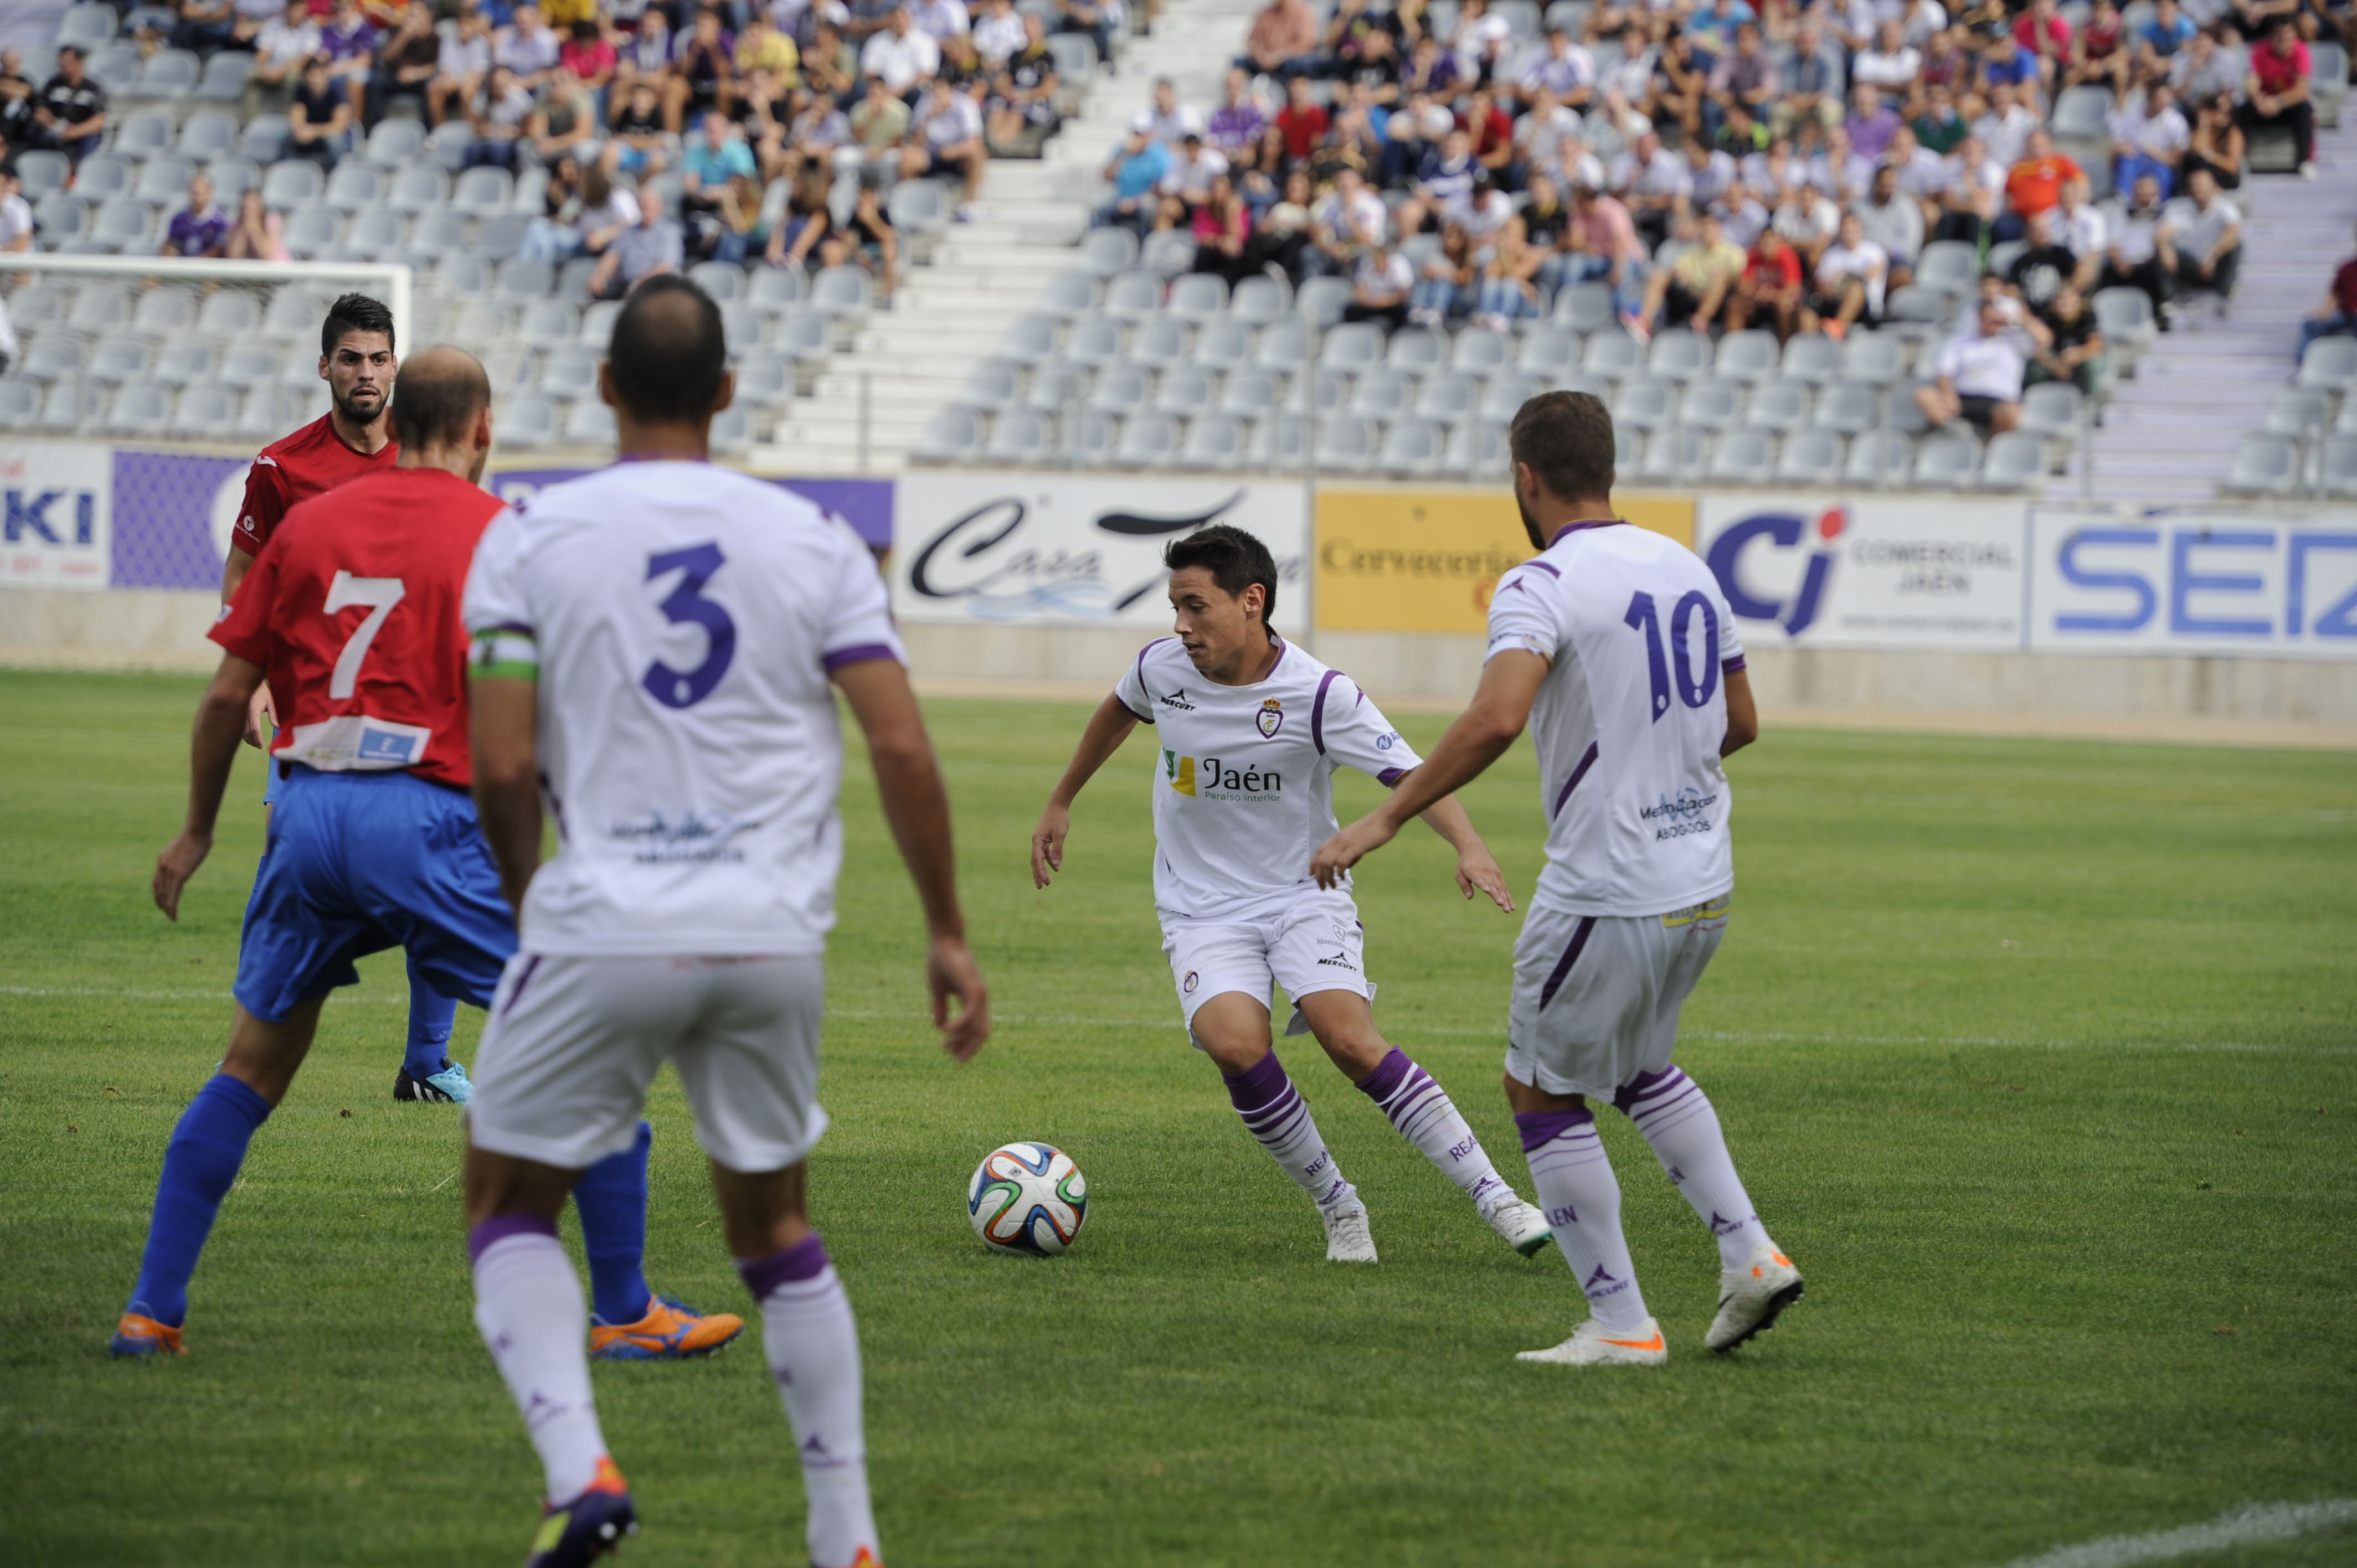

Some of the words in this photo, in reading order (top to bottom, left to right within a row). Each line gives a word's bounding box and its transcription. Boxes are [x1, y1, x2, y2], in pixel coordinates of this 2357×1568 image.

[1852, 539, 2015, 569] COMERCIAL
[323, 569, 407, 700] 7
[642, 541, 737, 710] 3
[1623, 589, 1719, 725] 10
[1160, 696, 1196, 711] MERCURY
[1203, 757, 1281, 792] Jaén
[1205, 791, 1241, 802] Paraíso
[1244, 793, 1281, 802] interior
[1316, 958, 1357, 972] MERCURY
